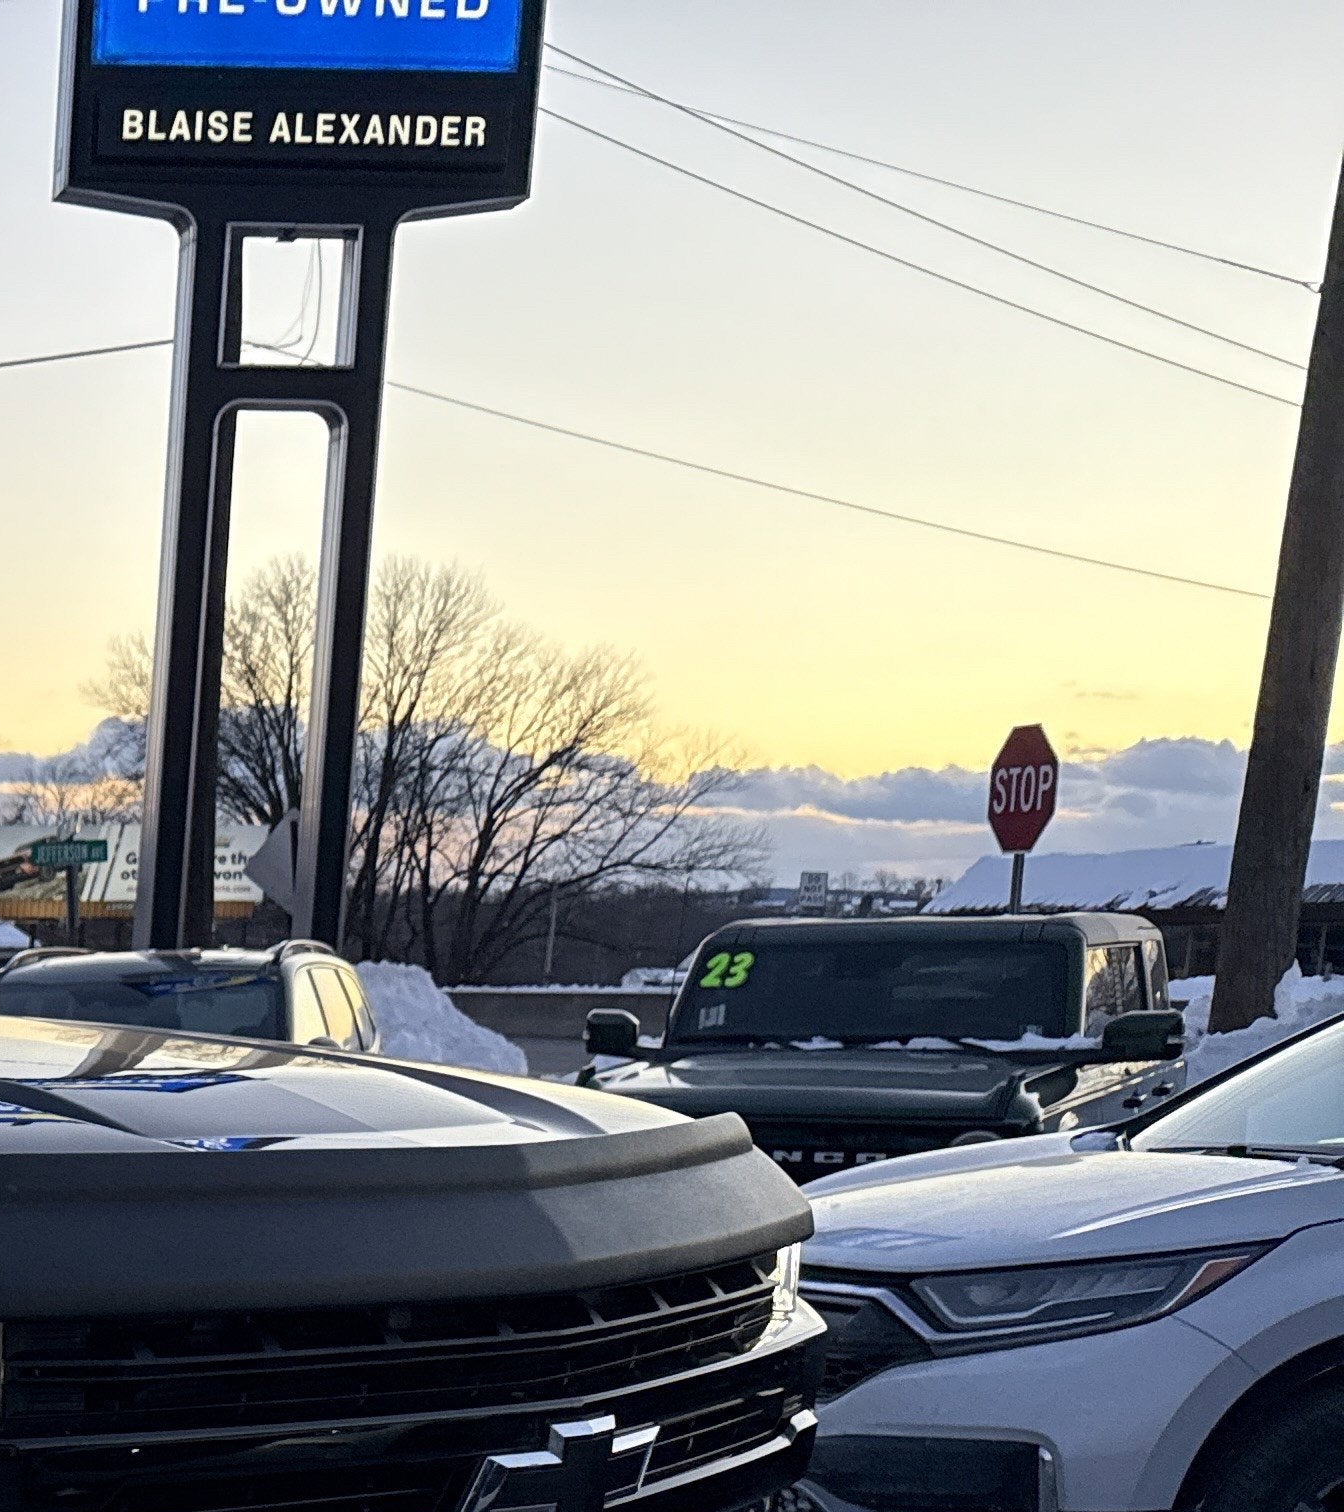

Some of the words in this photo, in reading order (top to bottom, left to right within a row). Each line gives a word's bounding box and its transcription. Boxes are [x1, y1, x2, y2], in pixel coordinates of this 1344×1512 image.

[137, 0, 489, 19] OWNED
[122, 109, 253, 142] BLAISE
[269, 112, 486, 147] ALEXANDER
[993, 763, 1054, 815] STOP
[699, 951, 755, 988] 23
